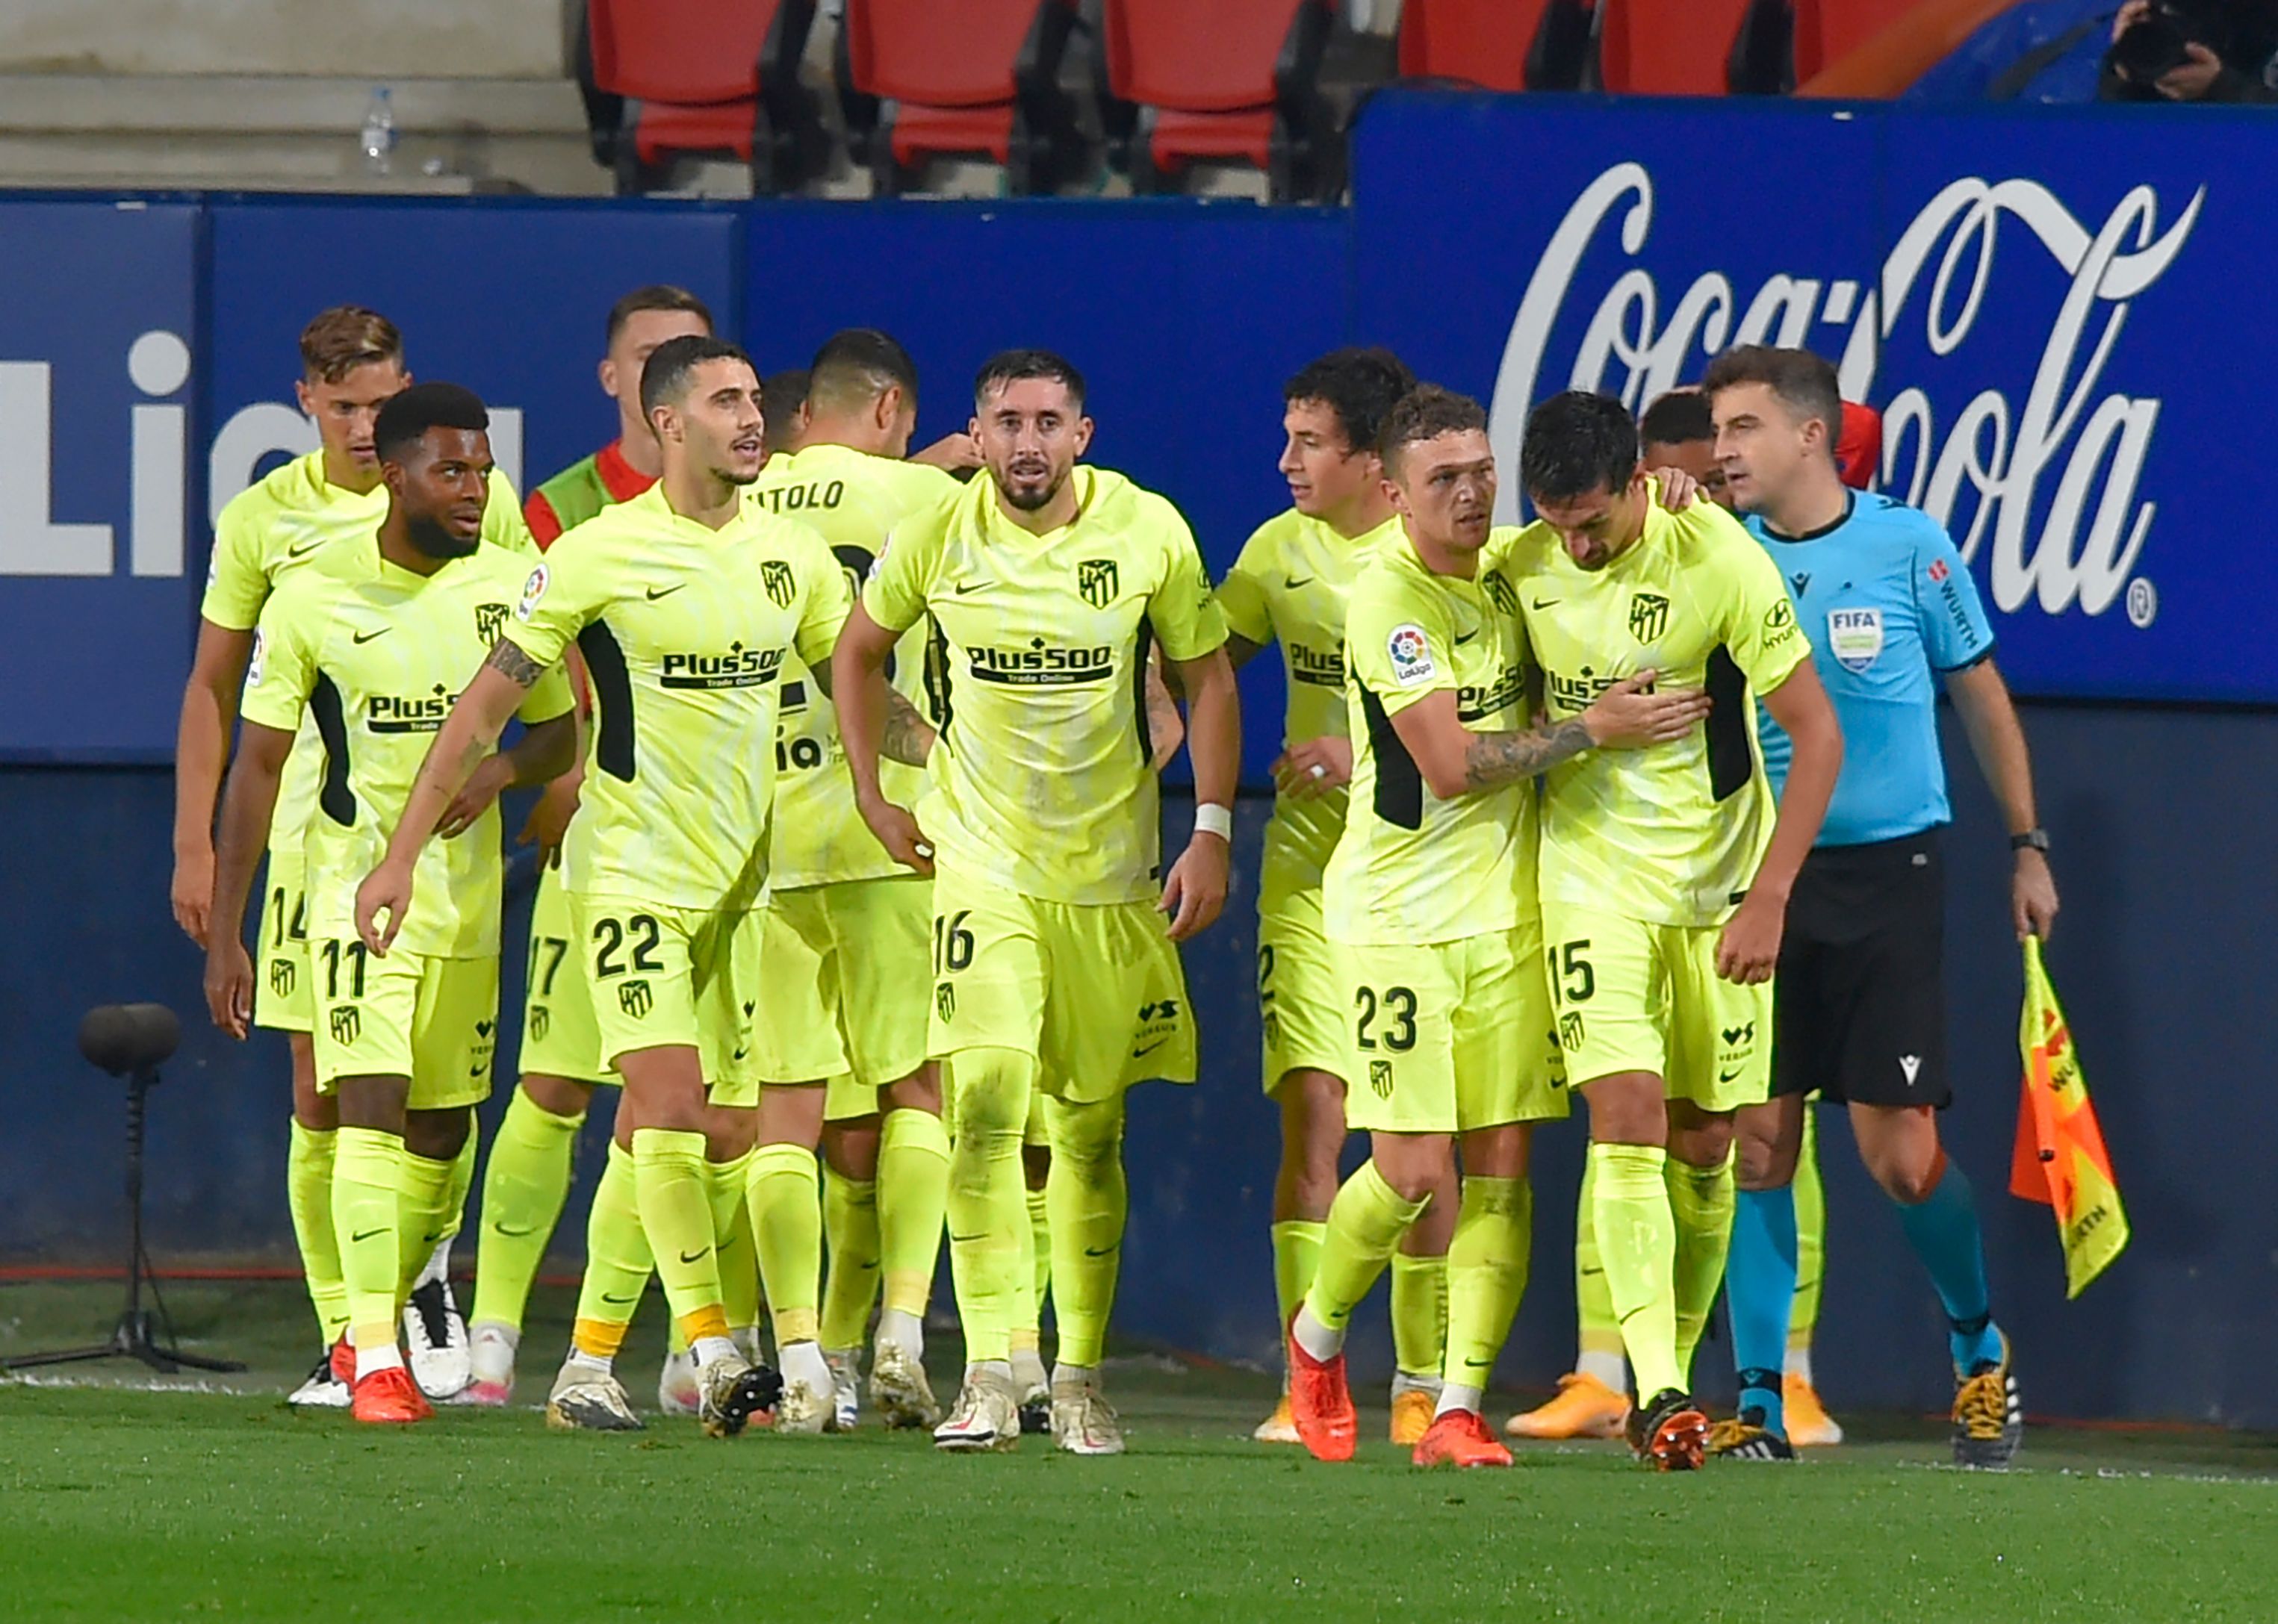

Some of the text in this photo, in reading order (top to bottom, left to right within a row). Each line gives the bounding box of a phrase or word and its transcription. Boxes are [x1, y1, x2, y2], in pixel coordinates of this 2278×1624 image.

[0, 330, 523, 576] Li
[746, 480, 844, 514] ITOLO
[1763, 622, 1798, 650] HYUN
[1834, 612, 1875, 629] FIFA
[966, 646, 1111, 670] Plus500
[1290, 643, 1344, 671] Plus
[369, 694, 460, 718] Plus
[592, 914, 665, 981] 22
[934, 909, 975, 977] 16
[320, 939, 367, 999] 11
[1548, 939, 1595, 1007] 15
[1354, 986, 1418, 1053] 23
